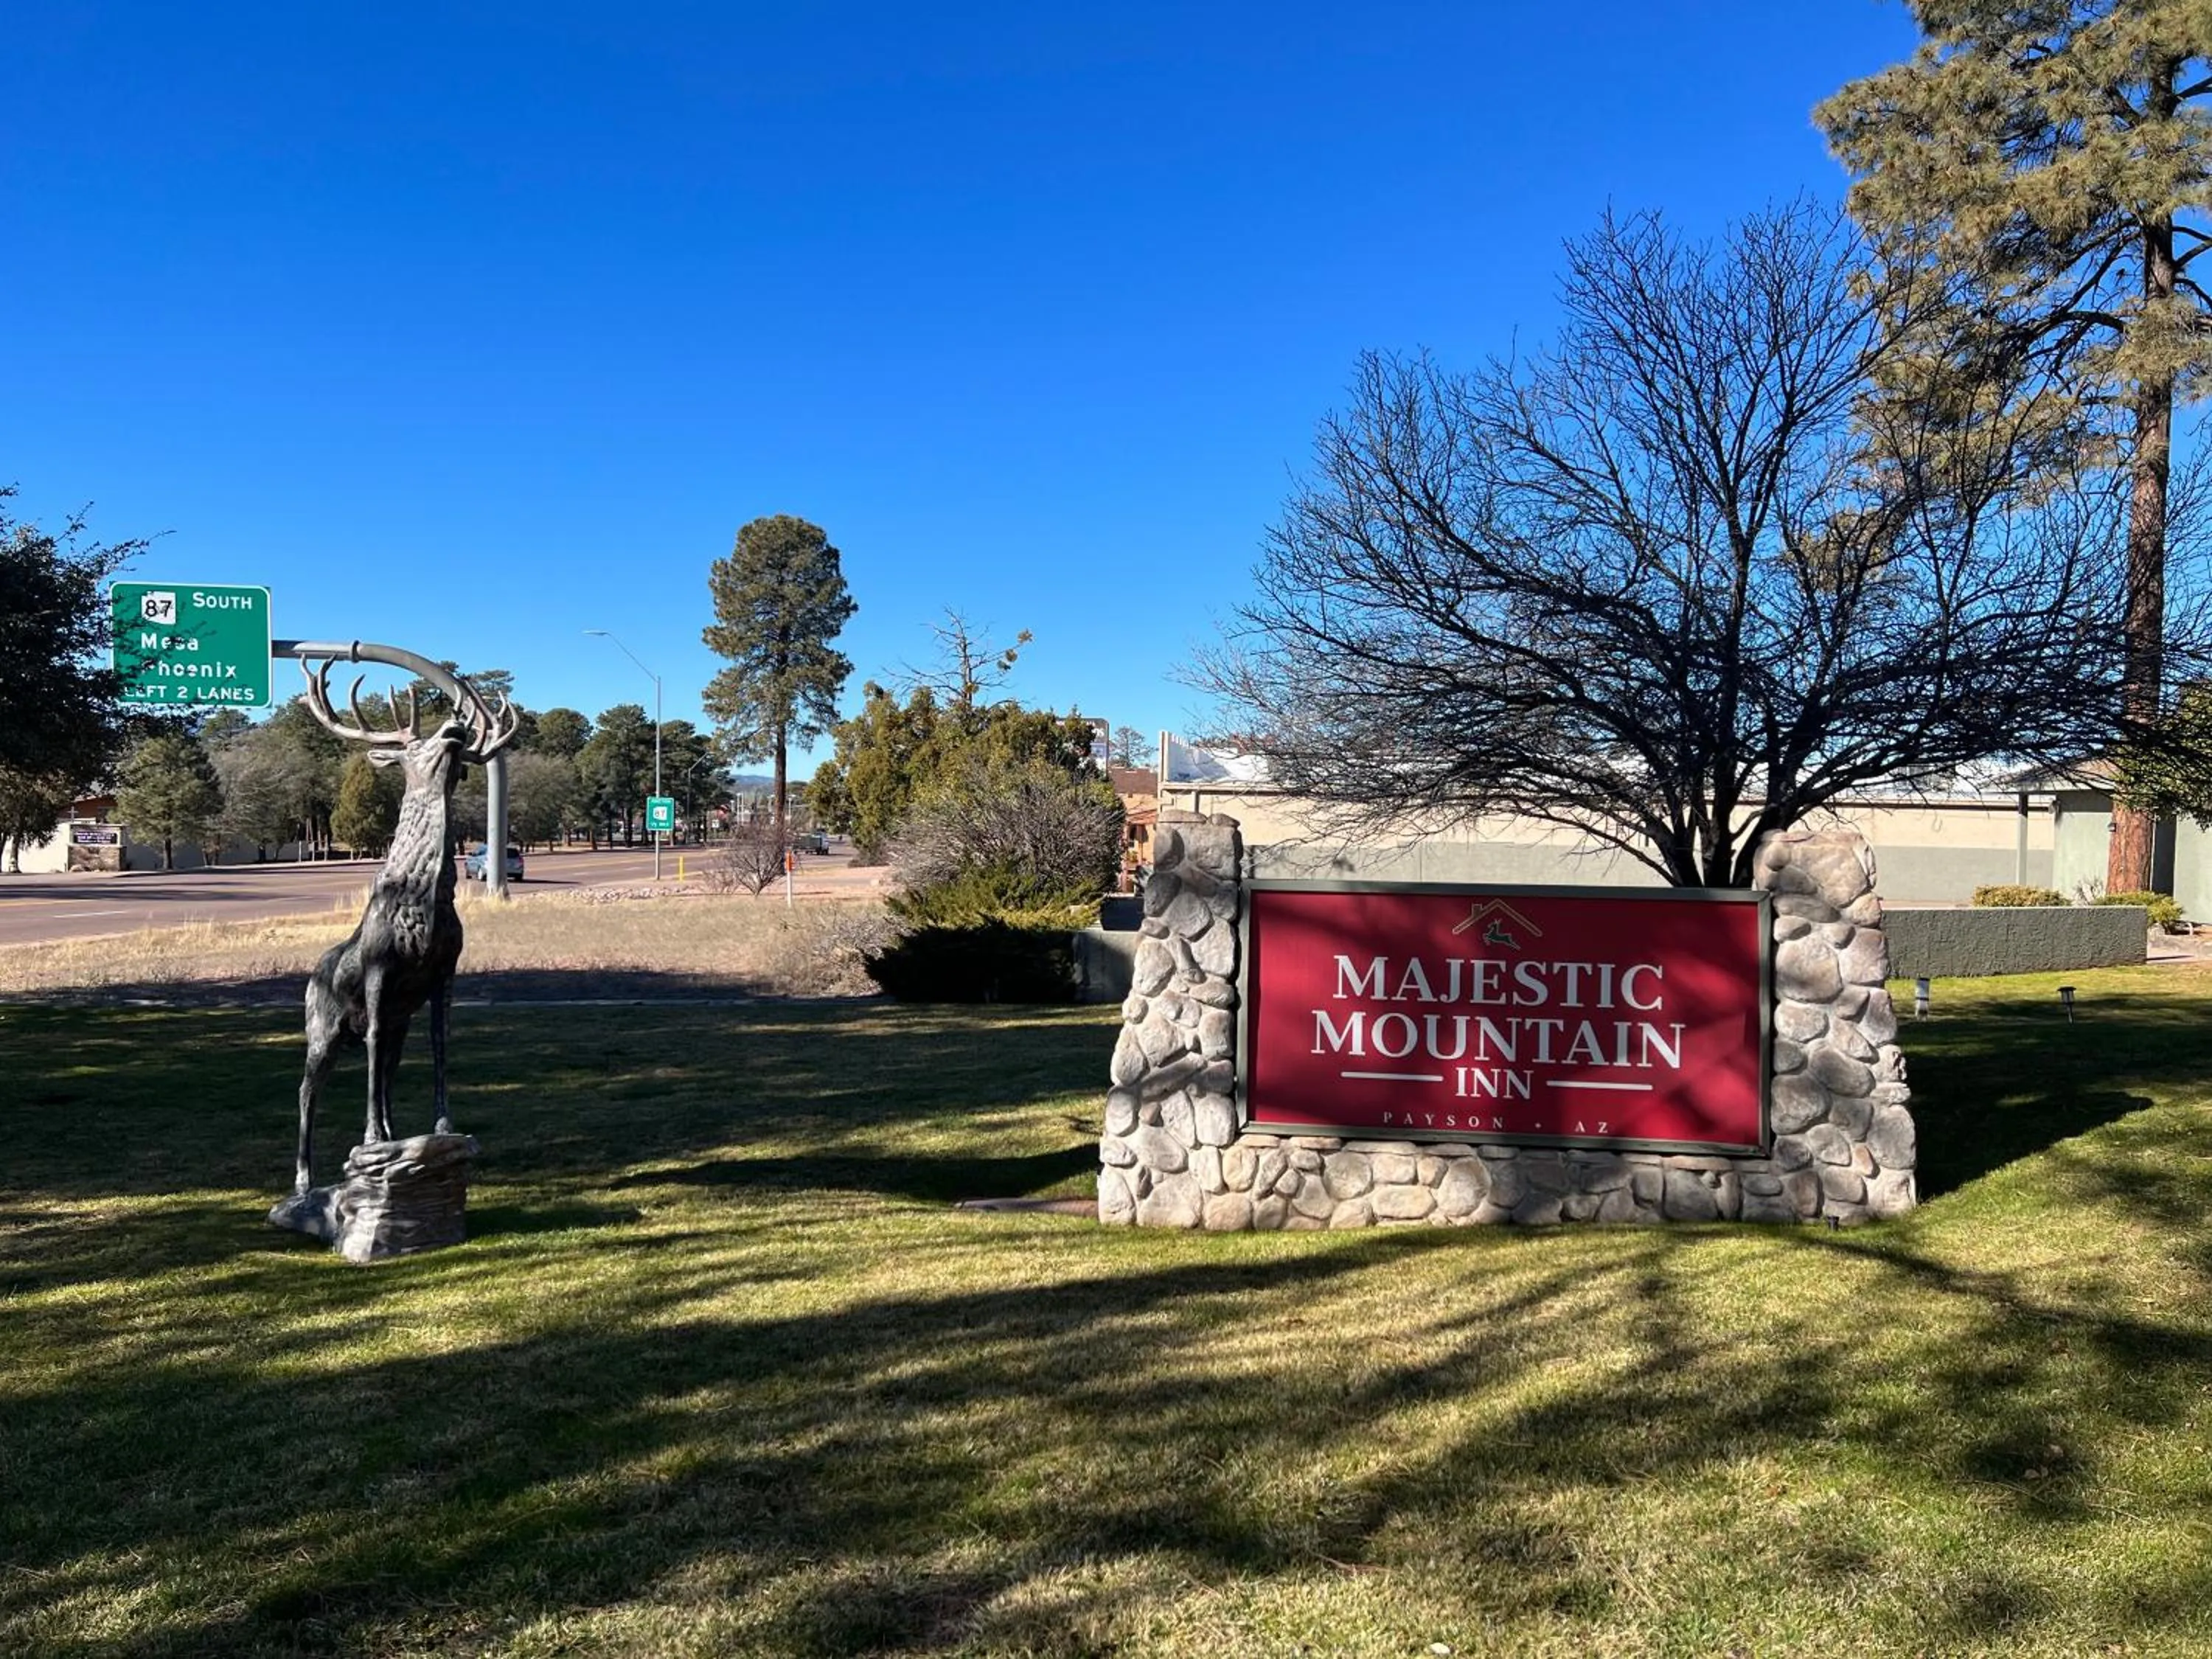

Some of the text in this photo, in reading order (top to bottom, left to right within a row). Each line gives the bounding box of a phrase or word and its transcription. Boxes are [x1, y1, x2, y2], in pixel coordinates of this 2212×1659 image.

[145, 599, 172, 618] 87
[141, 633, 199, 651] Mesa
[177, 686, 188, 699] 2
[197, 686, 255, 700] LANES
[1332, 954, 1664, 1011] MAJESTIC
[1310, 1009, 1686, 1069] MOUNTAIN
[1454, 1068, 1534, 1099] INN
[1383, 1111, 1610, 1135] PAYSON AZ
